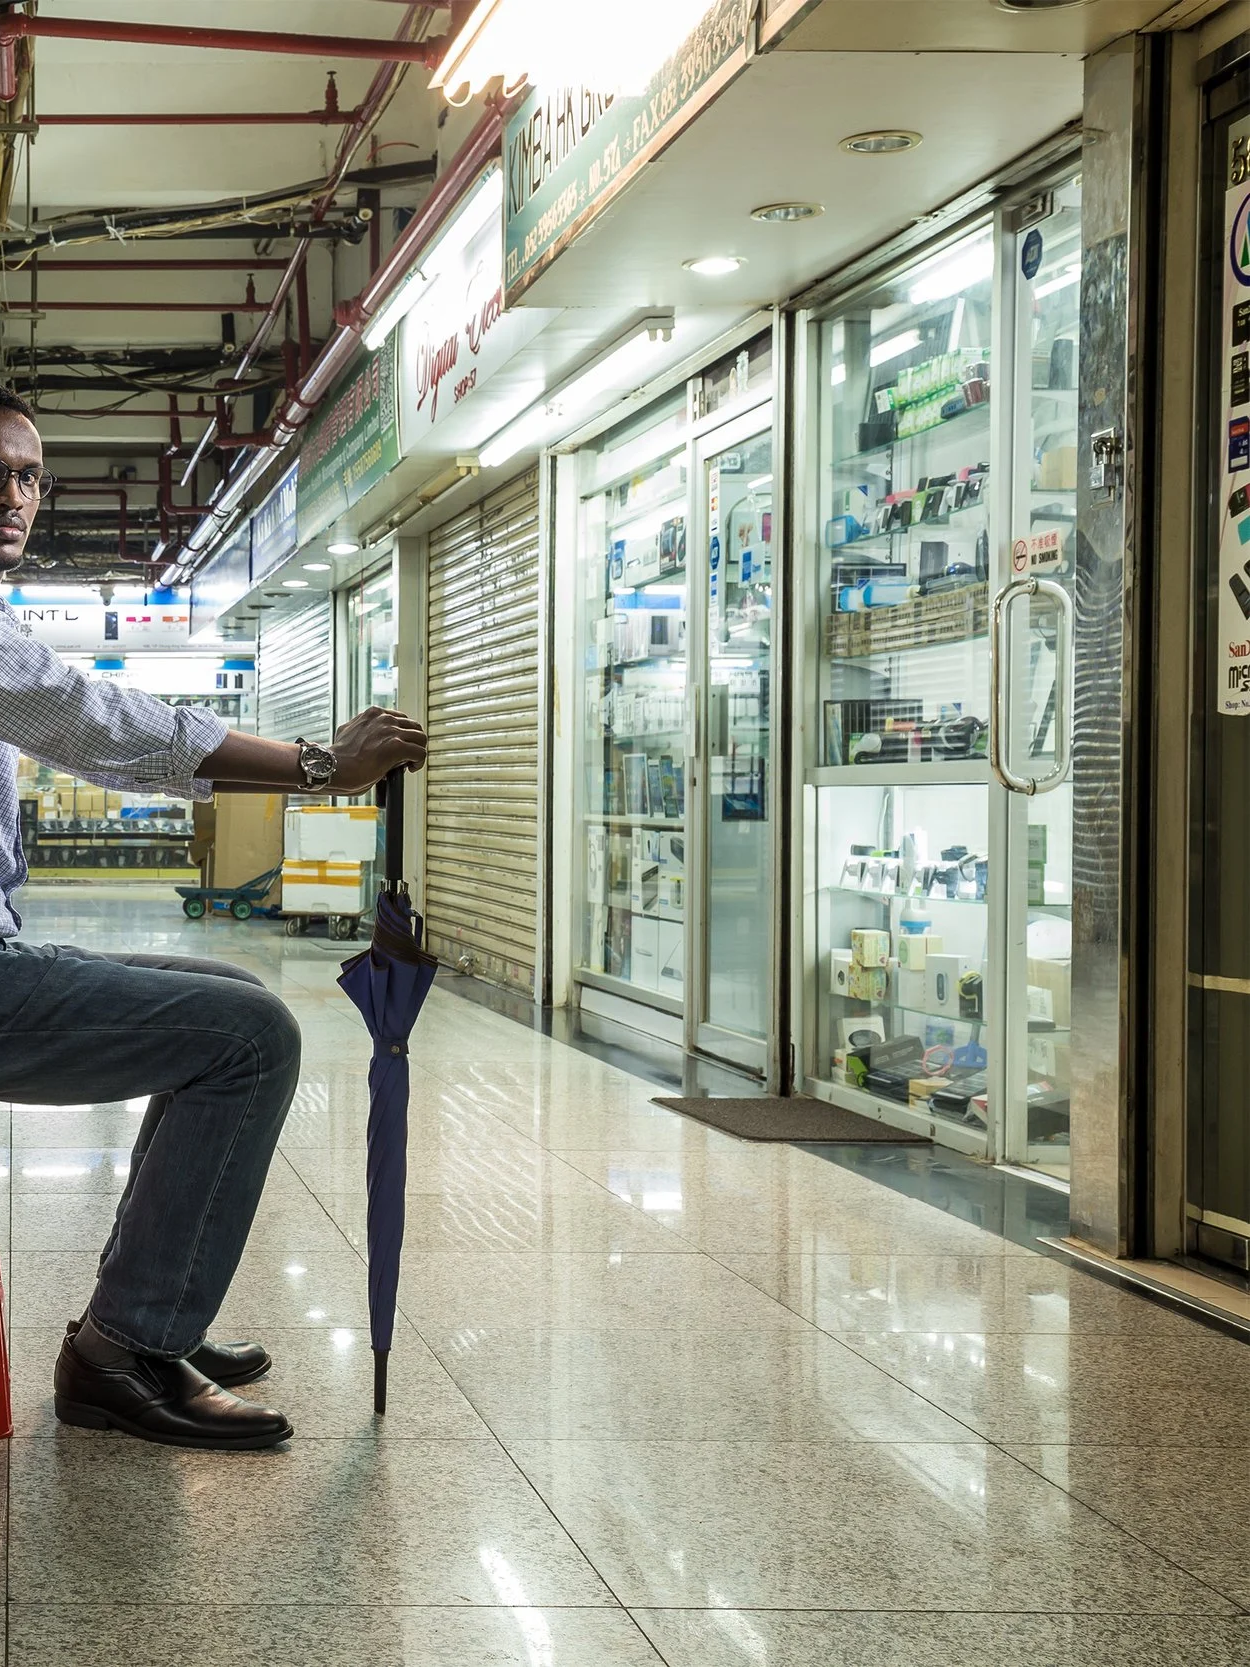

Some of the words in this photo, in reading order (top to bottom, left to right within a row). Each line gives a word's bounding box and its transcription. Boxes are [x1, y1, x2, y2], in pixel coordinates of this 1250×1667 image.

[508, 93, 552, 224] KIMBA
[1031, 554, 1037, 566] NO
[1038, 549, 1058, 564] SMOKING
